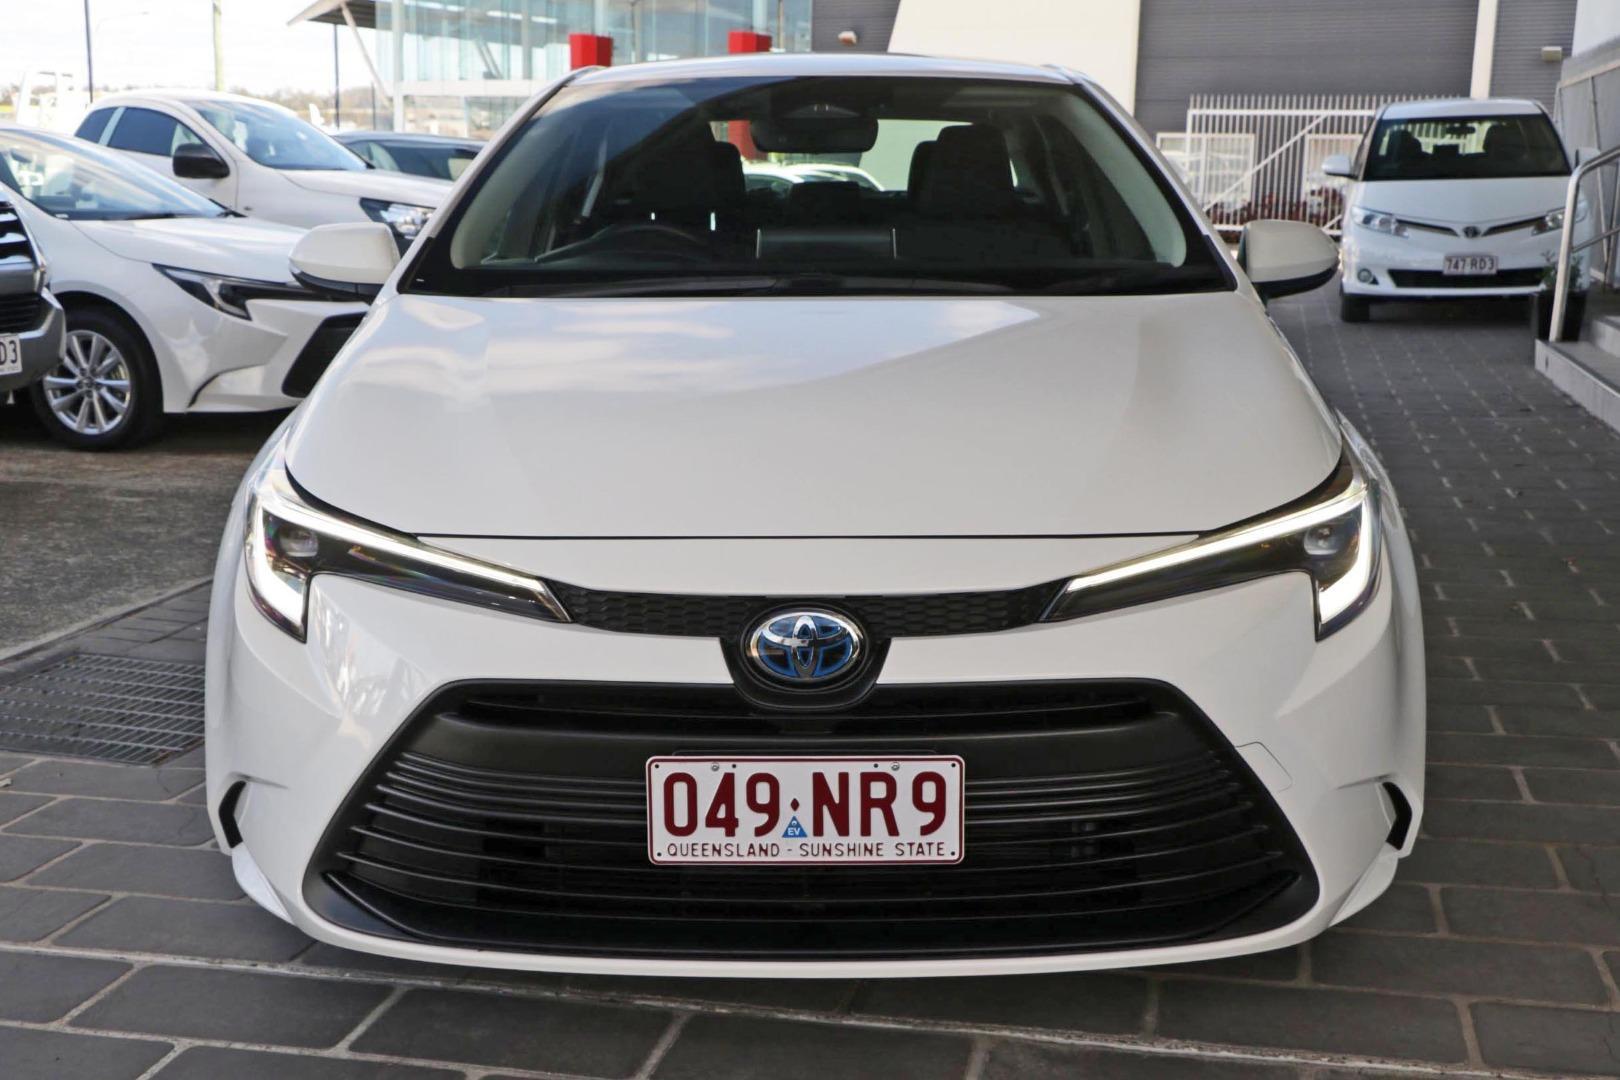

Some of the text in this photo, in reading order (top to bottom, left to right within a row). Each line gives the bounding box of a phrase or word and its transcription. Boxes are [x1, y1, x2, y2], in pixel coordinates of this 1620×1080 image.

[1445, 257, 1494, 270] 747 RD3
[663, 771, 947, 837] 049 NR9
[787, 827, 801, 836] EV
[667, 843, 780, 857] QUEENSLAND
[800, 842, 883, 857] SUNSHINE
[895, 841, 945, 856] STATE
